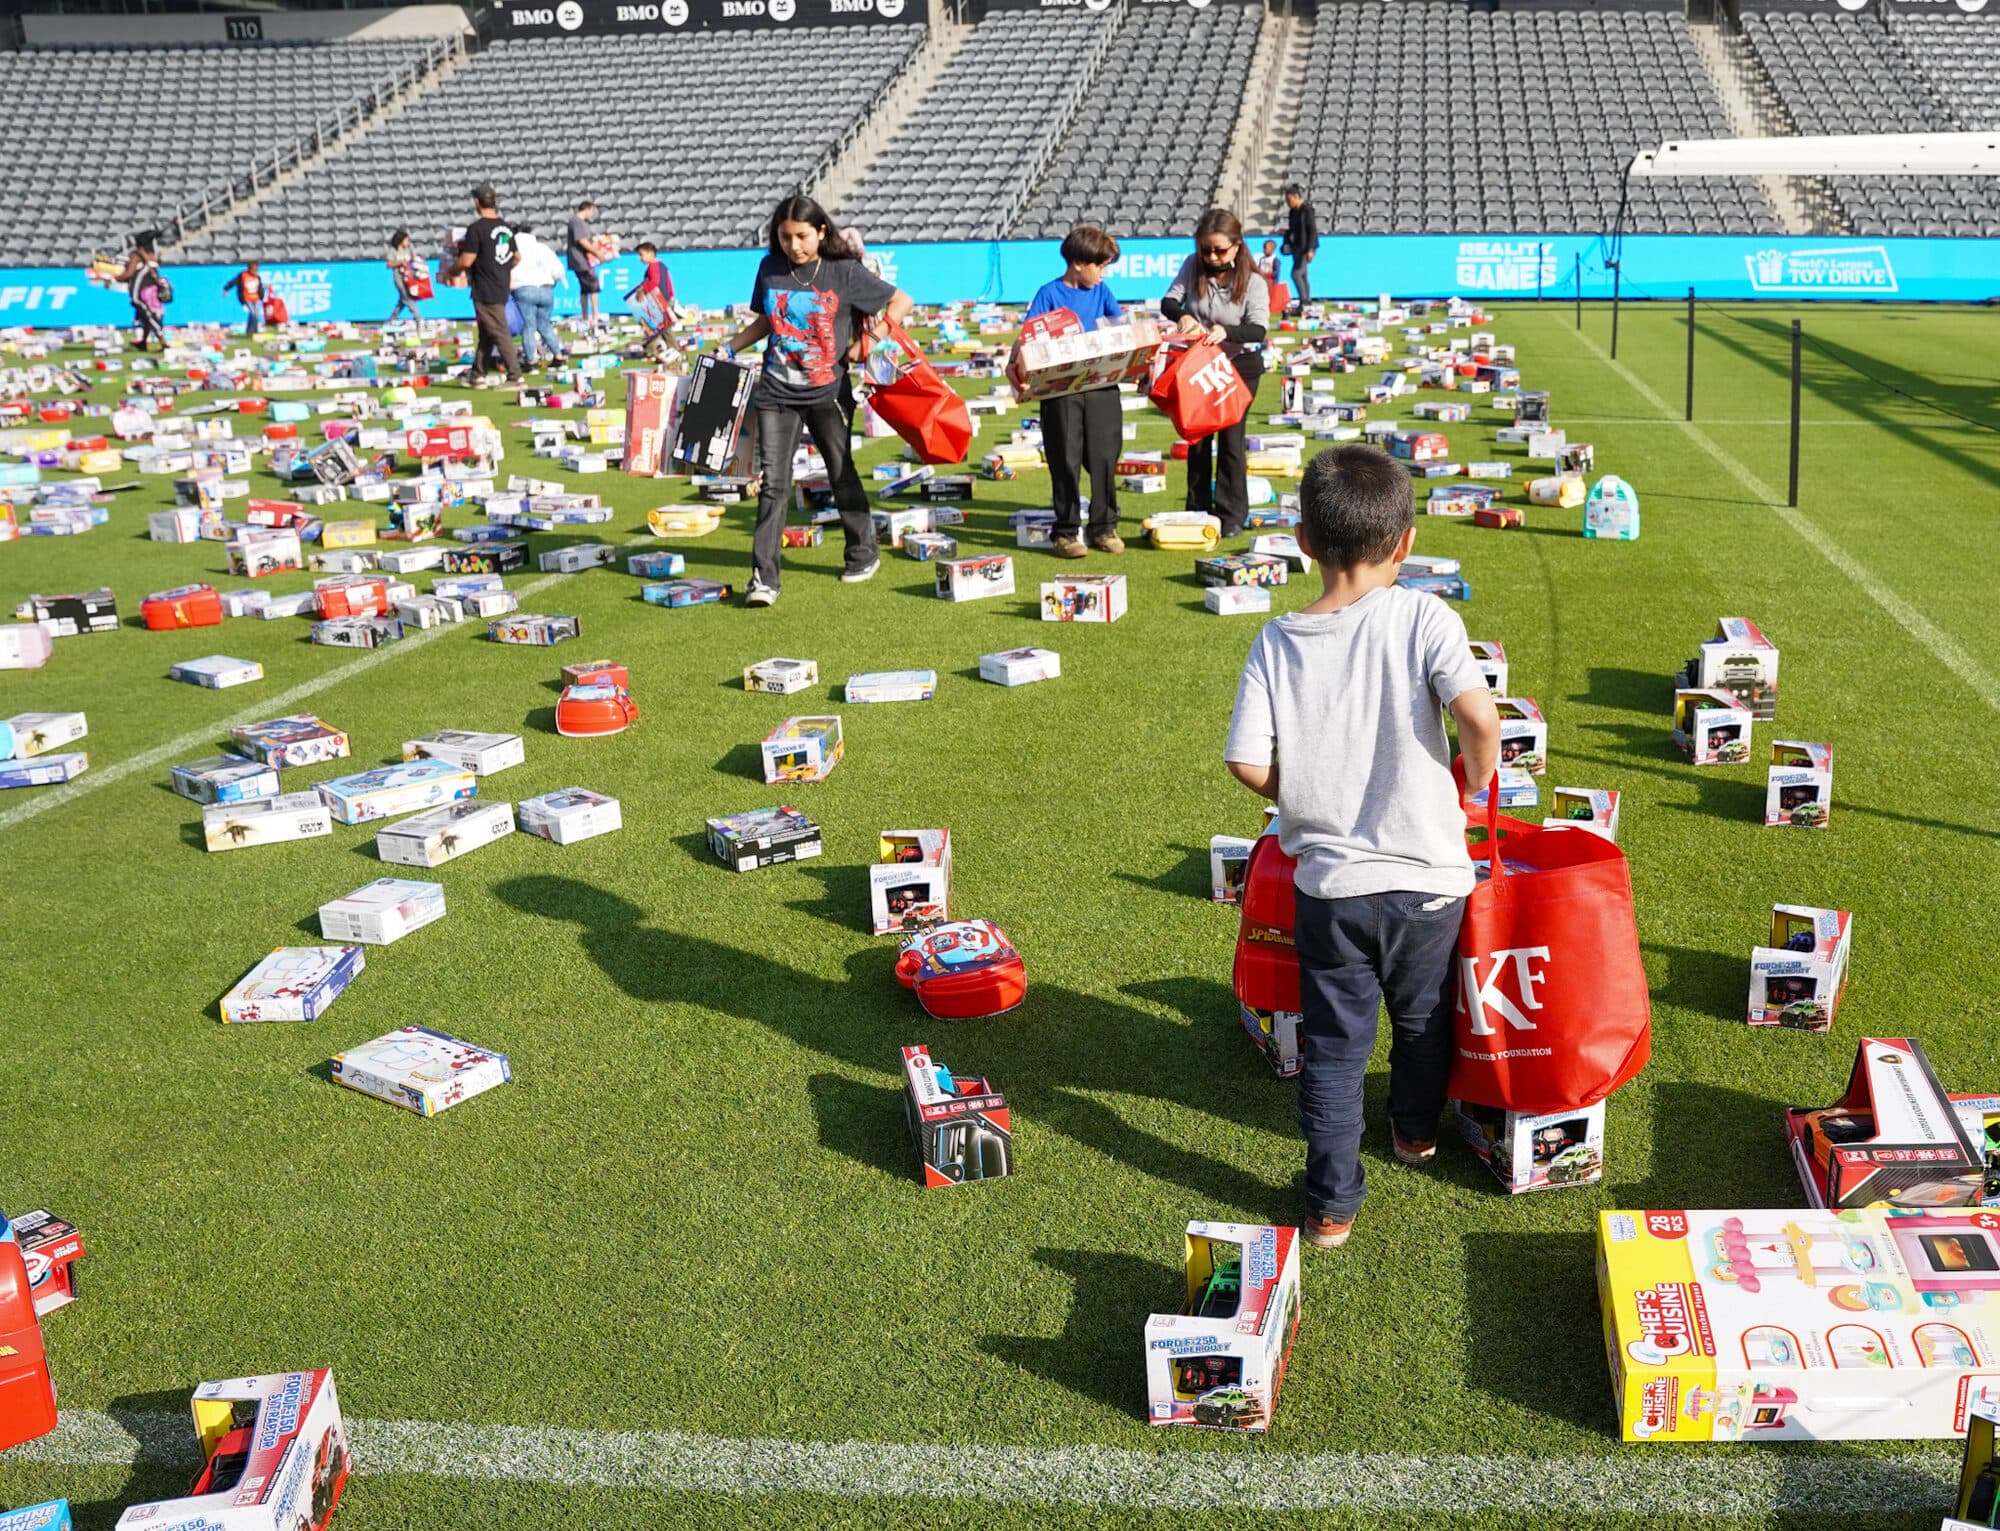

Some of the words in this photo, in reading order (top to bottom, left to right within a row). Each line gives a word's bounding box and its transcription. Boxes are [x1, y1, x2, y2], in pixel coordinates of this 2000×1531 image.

[616, 5, 658, 21] BMO
[722, 1, 765, 17] BMO
[512, 10, 553, 25] BMO
[230, 22, 258, 38] 110
[1459, 242, 1554, 256] REALITY
[261, 269, 328, 283] EALITY
[1457, 263, 1557, 290] GAMES
[1788, 269, 1826, 284] TOY
[1829, 269, 1886, 284] DRIVE
[1456, 945, 1551, 1036] KF
[1497, 1048, 1552, 1060] FOUNDATION
[1650, 1215, 1671, 1232] 28
[1672, 1215, 1685, 1232] PCS
[1980, 1214, 1999, 1228] 3+
[1263, 1228, 1274, 1251] FORD
[1637, 1290, 1680, 1356] CHEF'S
[1650, 1283, 1690, 1356] CUISINE
[1151, 1340, 1181, 1351] FORD
[1185, 1336, 1217, 1347] F-250
[283, 1374, 302, 1402] FORD
[1246, 1378, 1260, 1387] 6+
[279, 1402, 301, 1434] F-150
